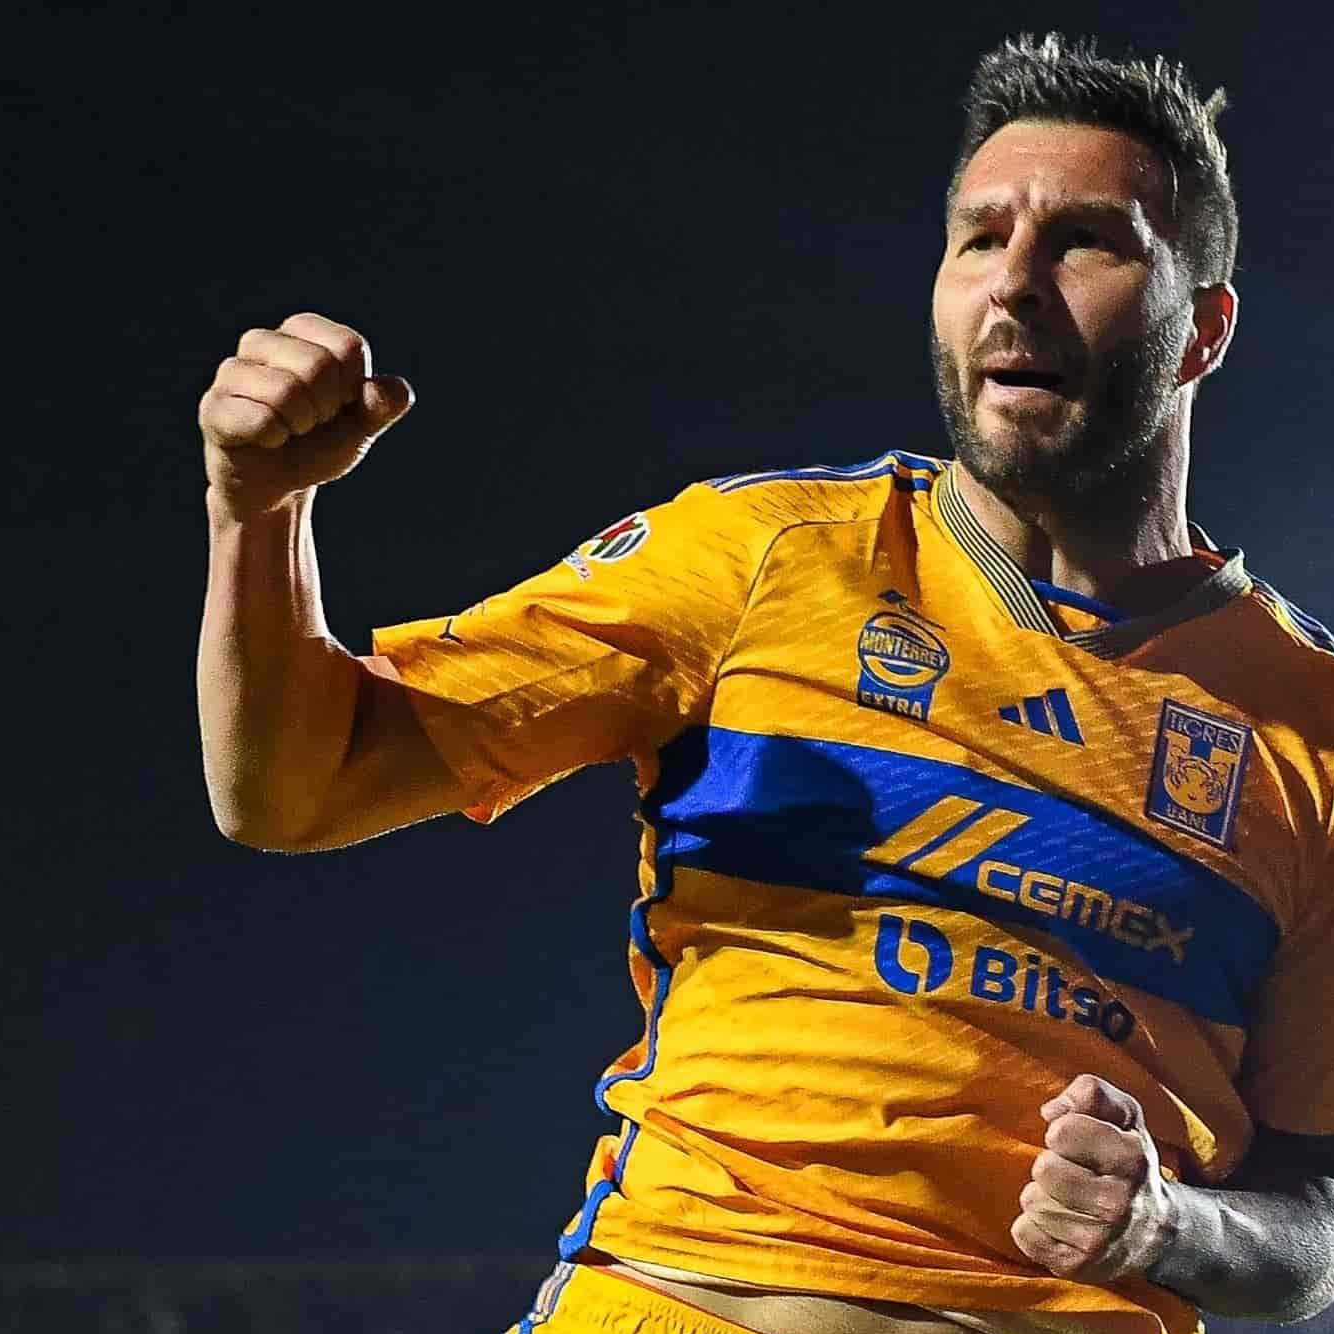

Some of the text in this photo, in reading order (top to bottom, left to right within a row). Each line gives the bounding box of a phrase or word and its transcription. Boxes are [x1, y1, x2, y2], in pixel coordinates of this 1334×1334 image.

[860, 629, 948, 668] MONTERREY
[861, 692, 923, 718] EXTRA
[1170, 712, 1240, 752] TIGRES
[976, 860, 1195, 965] CEMEX
[970, 945, 1136, 1043] Bitso
